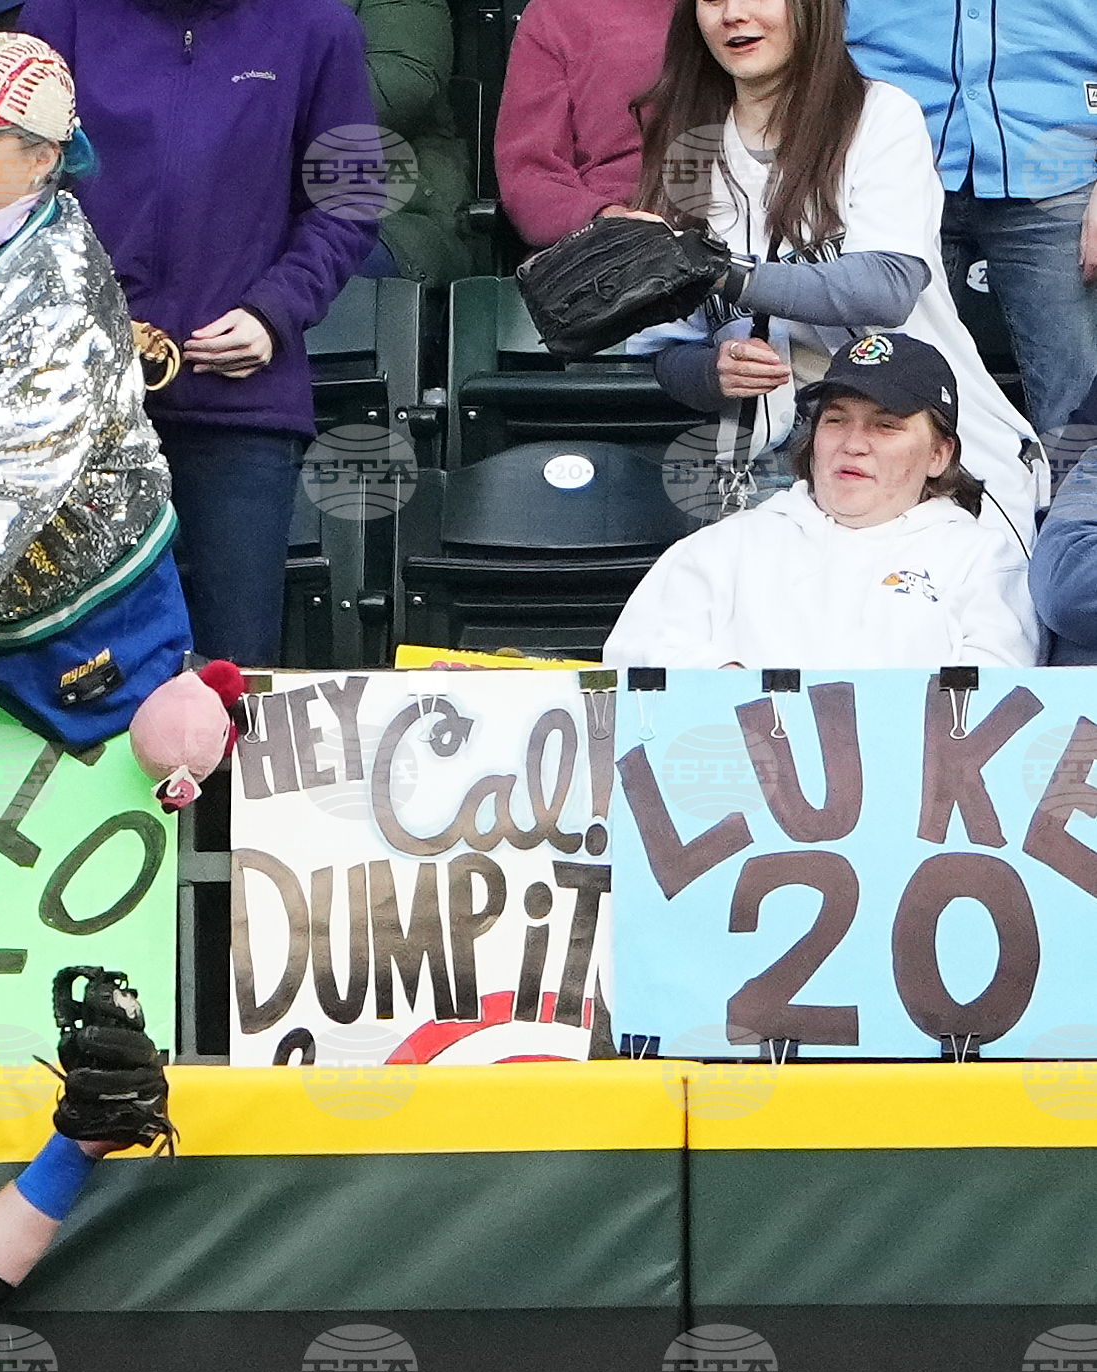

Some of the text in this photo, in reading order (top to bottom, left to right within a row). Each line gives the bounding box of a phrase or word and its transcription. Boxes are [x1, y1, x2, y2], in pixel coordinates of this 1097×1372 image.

[554, 463, 584, 480] 20
[235, 675, 617, 856] HEY Cal!
[231, 848, 507, 1034] DUMP
[726, 850, 1041, 1047] 20
